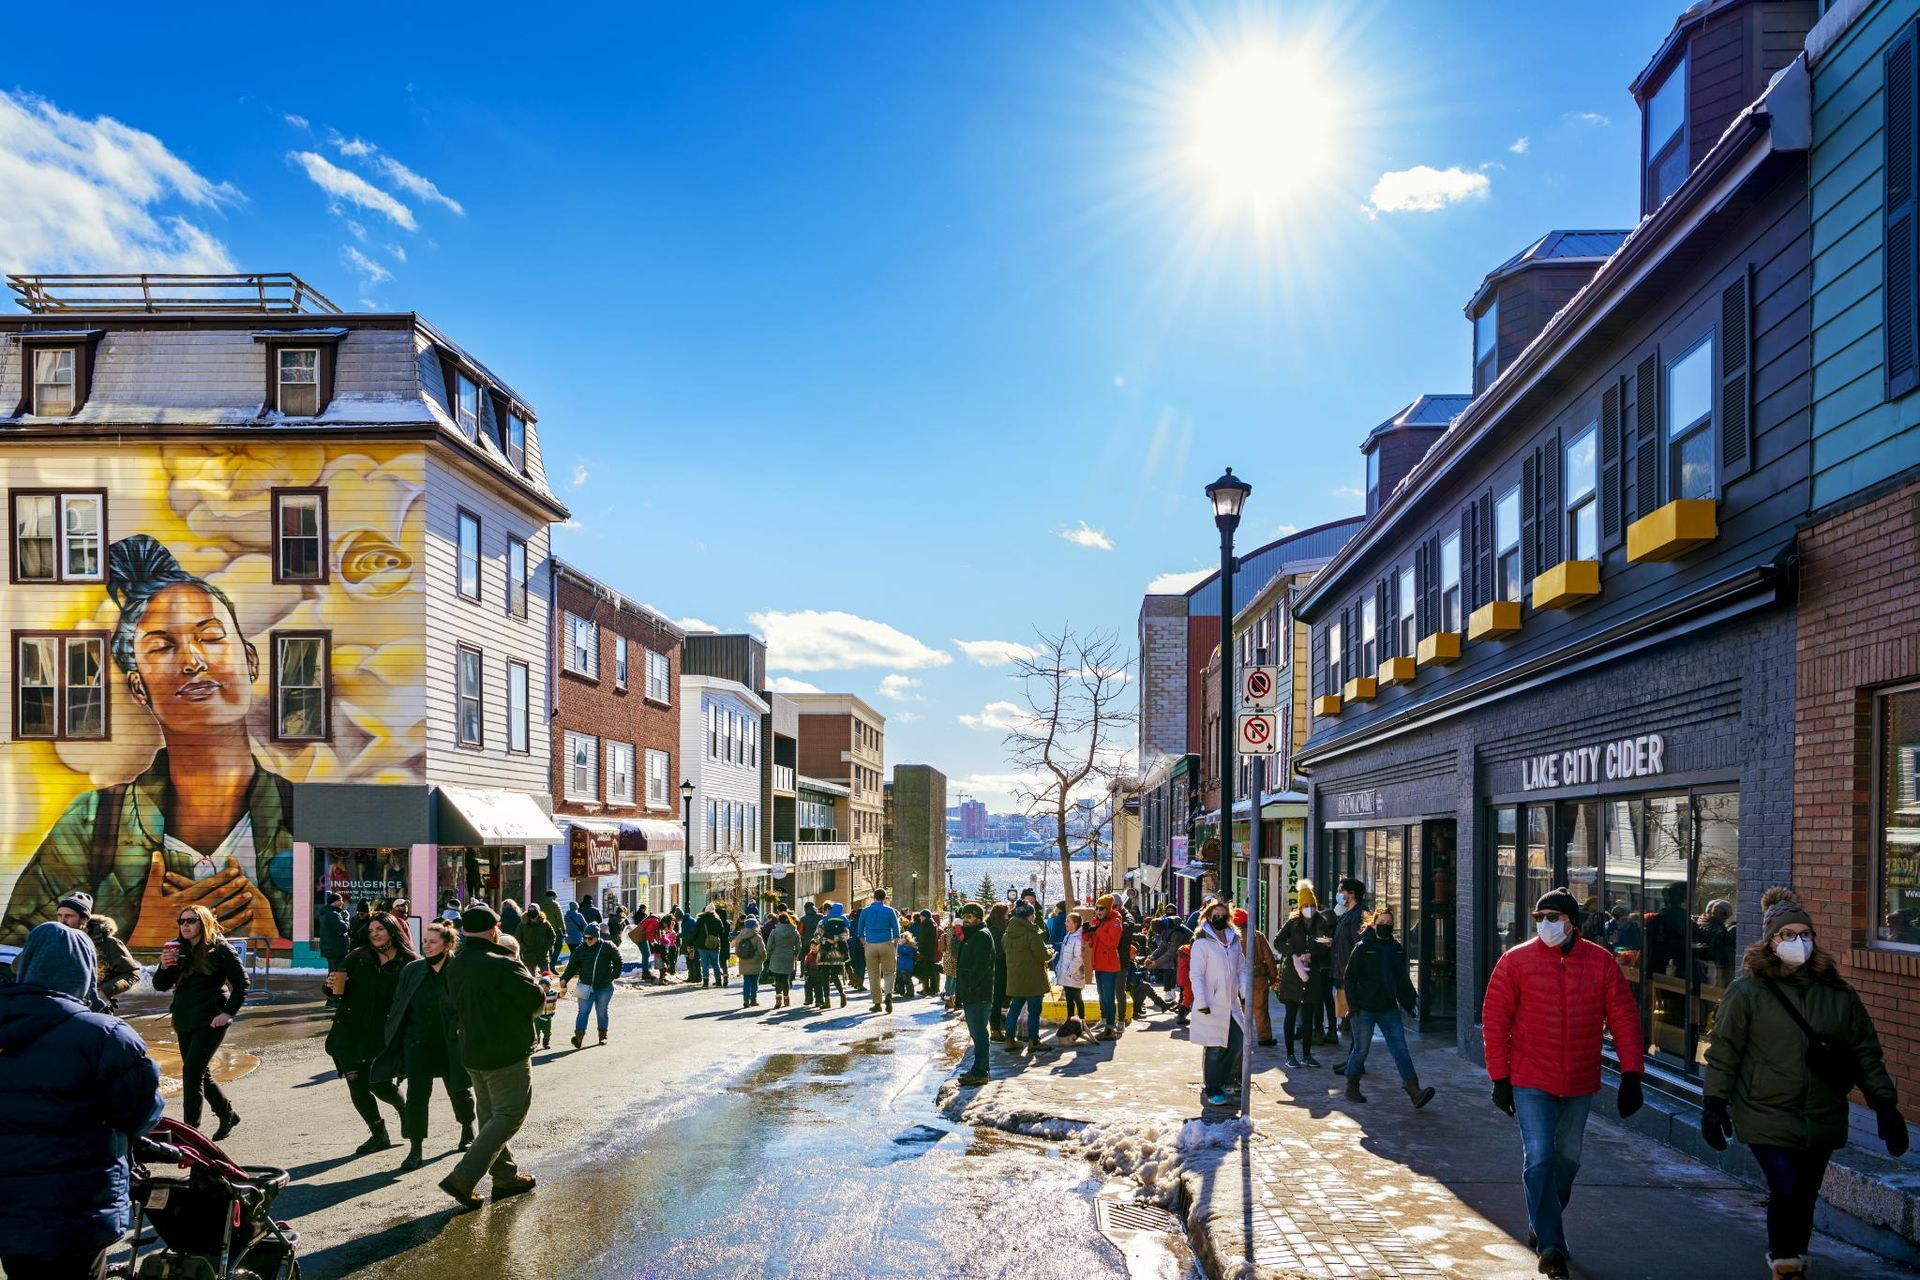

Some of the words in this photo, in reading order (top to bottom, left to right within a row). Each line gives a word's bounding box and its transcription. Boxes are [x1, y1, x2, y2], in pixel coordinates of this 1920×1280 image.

[1522, 753, 1559, 790] LAKE
[1564, 746, 1602, 785] CITY
[1606, 734, 1665, 780] CIDER
[331, 880, 403, 889] INDULGENCE
[1289, 846, 1298, 893] REVANA
